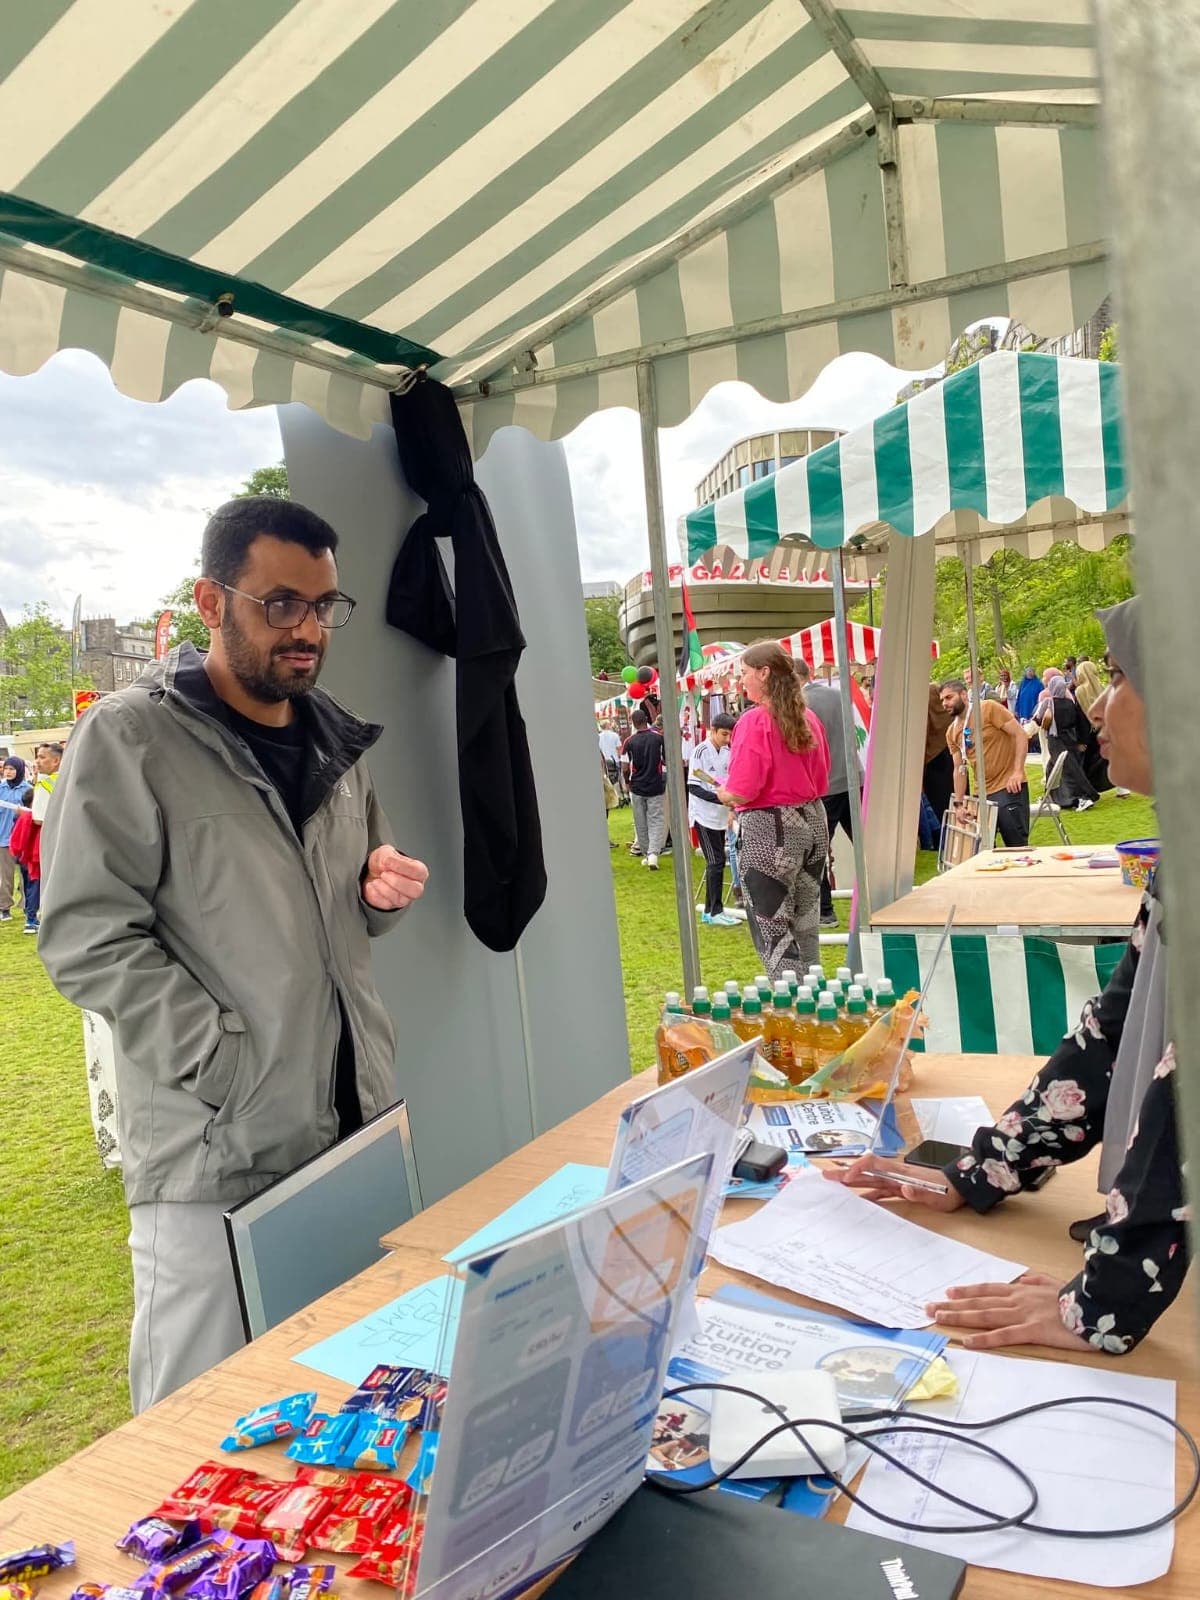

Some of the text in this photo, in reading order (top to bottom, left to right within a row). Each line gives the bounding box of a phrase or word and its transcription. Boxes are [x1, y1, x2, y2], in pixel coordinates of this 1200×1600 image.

[816, 1101, 835, 1124] Tuition
[690, 1332, 783, 1371] Centre
[703, 1320, 792, 1359] Tuition
